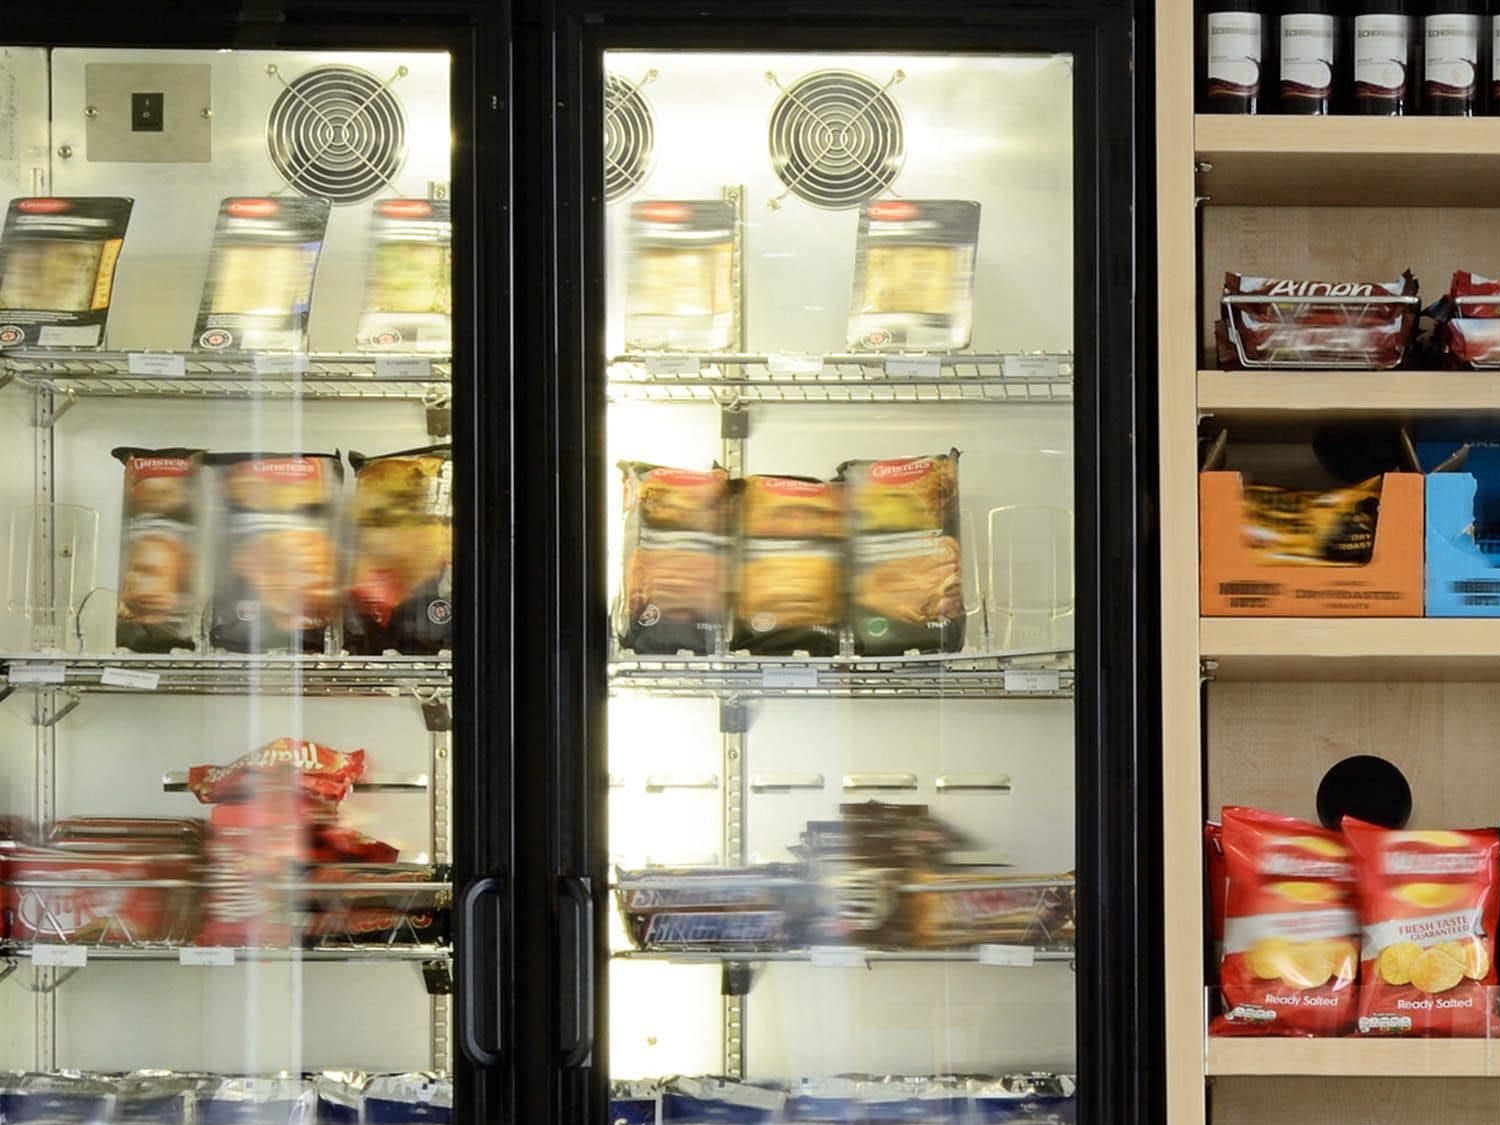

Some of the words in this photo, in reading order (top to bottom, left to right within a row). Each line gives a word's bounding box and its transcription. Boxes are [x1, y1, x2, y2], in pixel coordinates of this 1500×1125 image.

[1265, 994, 1301, 1007] Ready
[1303, 995, 1339, 1007] Salted
[1397, 999, 1434, 1011] Ready
[1436, 998, 1473, 1009] Salted
